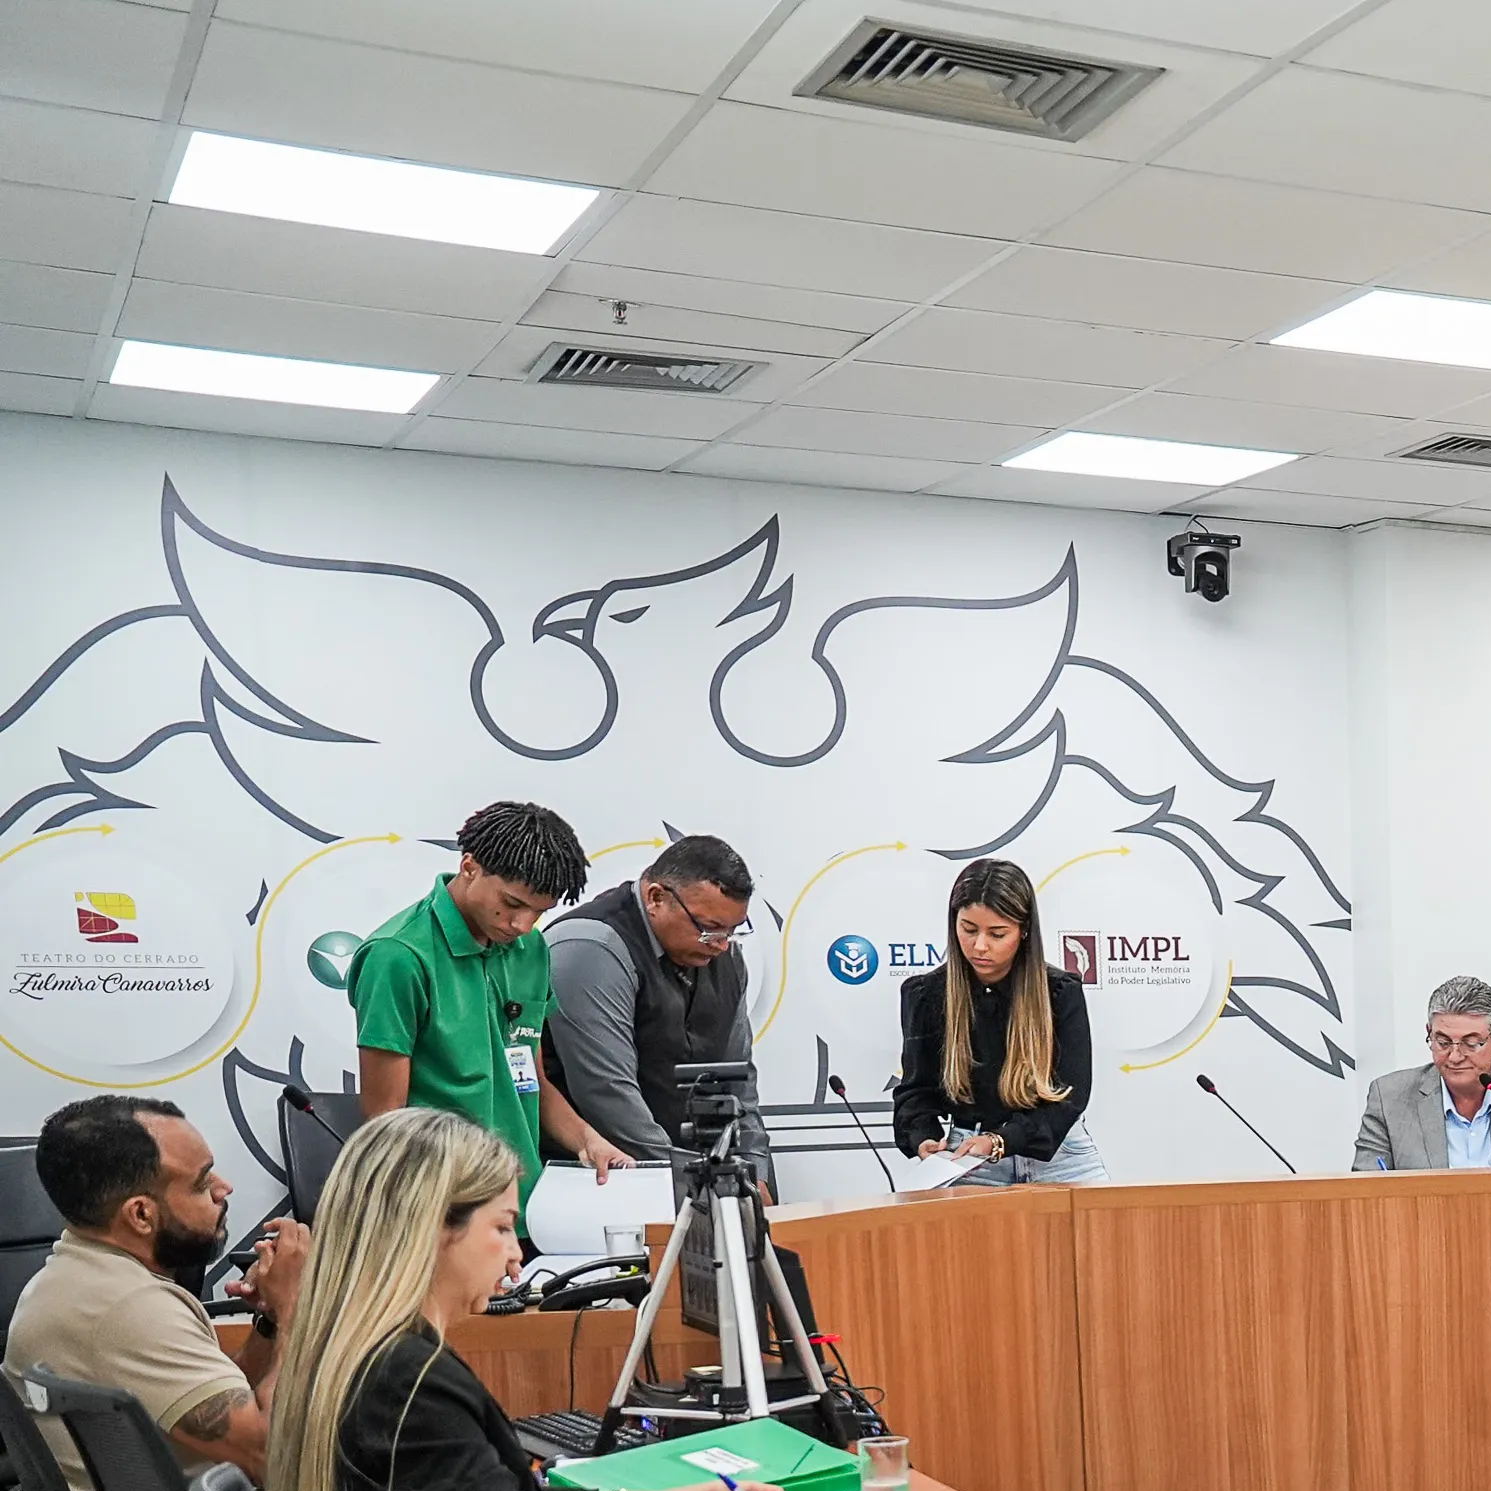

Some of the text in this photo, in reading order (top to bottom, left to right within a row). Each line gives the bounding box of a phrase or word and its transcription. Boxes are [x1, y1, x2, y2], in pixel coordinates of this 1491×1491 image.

[888, 943, 948, 966] ELM
[1107, 936, 1190, 961] IMPL
[20, 953, 199, 964] TEATRO DO CERRADO
[1108, 965, 1190, 973] Instituto Memória
[9, 972, 214, 1000] Zulmira Canavarros
[1108, 976, 1191, 986] do Poder Legislativo
